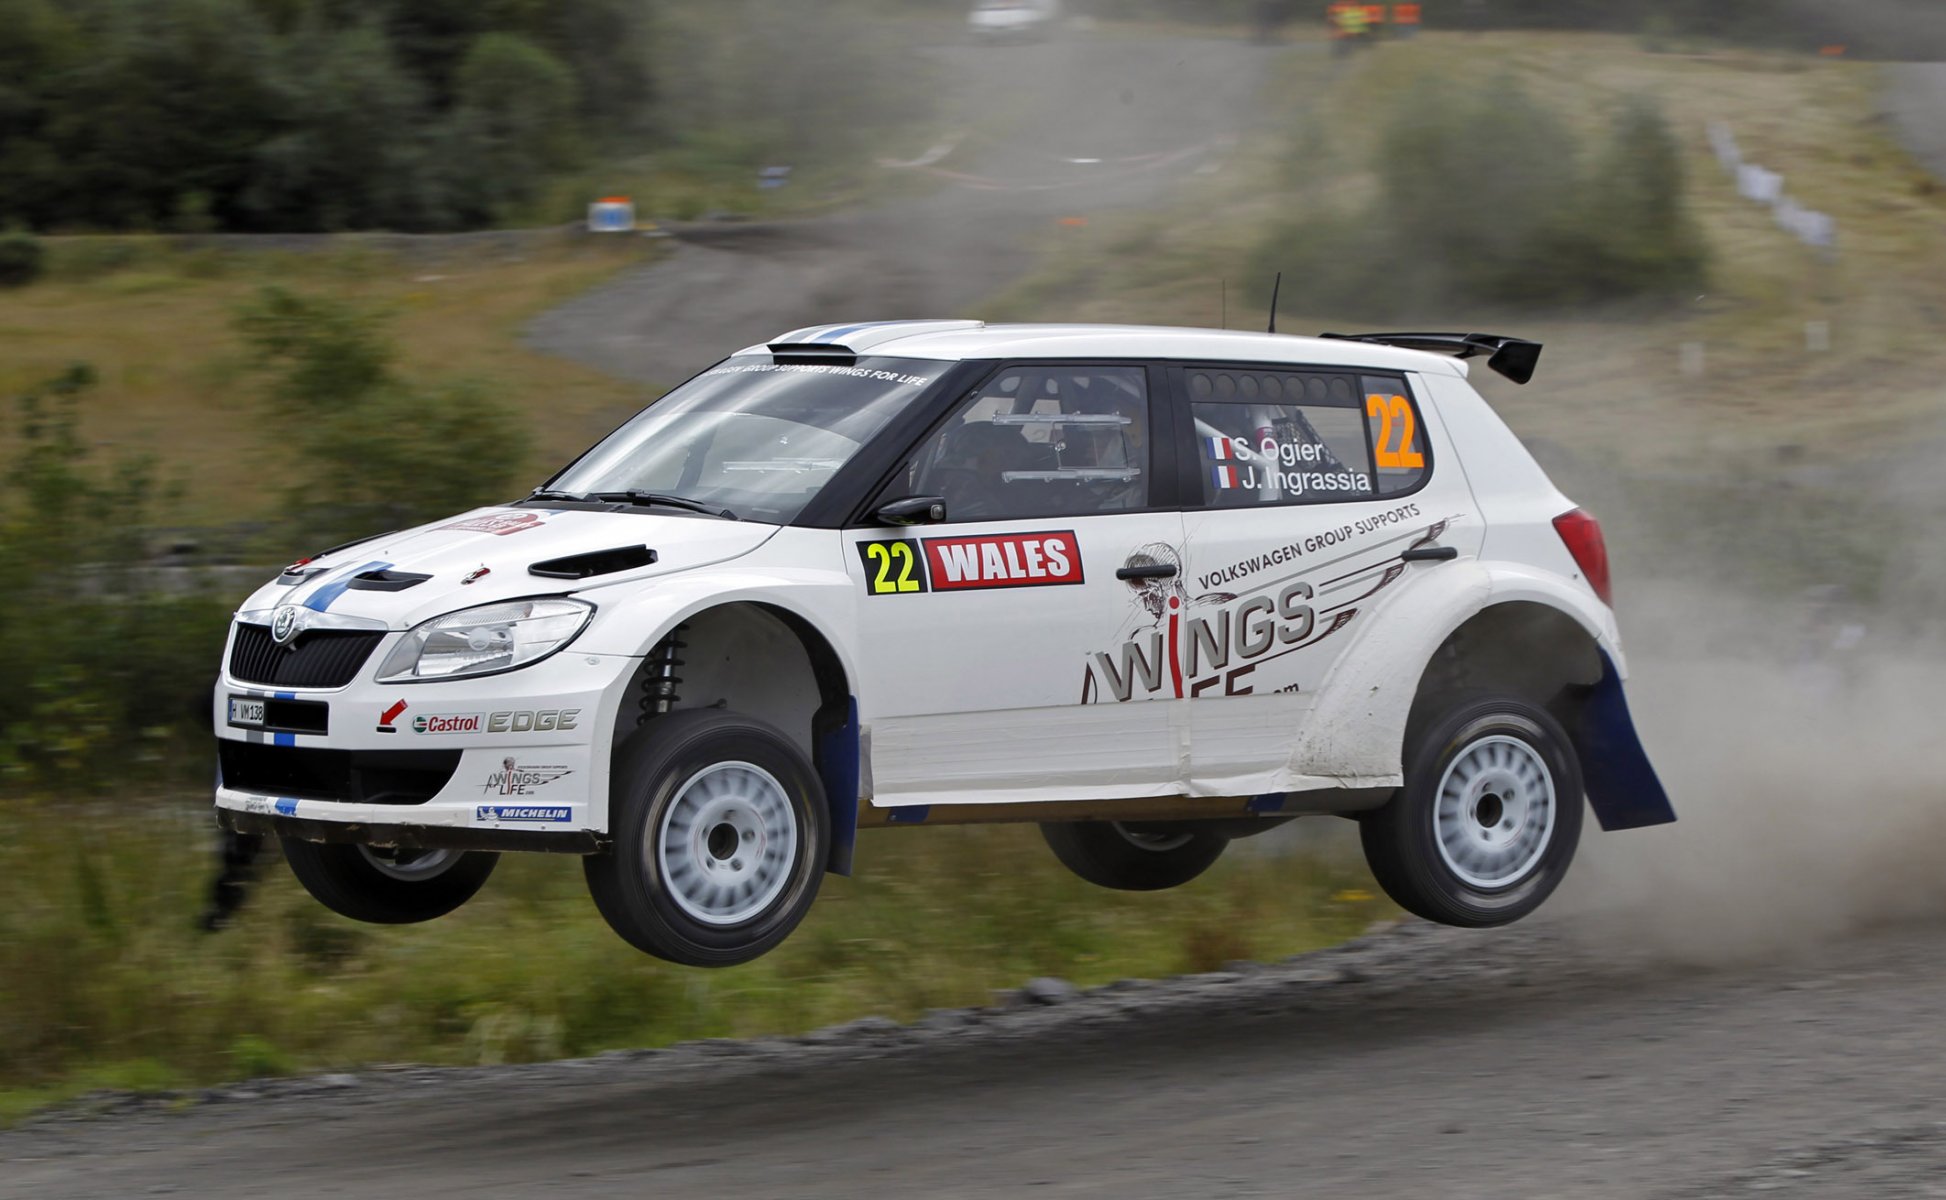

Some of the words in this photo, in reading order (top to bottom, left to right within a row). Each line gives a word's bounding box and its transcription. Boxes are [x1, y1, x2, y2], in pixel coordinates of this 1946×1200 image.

[829, 366, 872, 377] WINGS
[869, 370, 899, 381] FOR
[897, 374, 928, 386] LIFE
[1366, 394, 1425, 468] 22
[1234, 437, 1258, 461] S.
[1260, 437, 1323, 467] Ogier
[1242, 466, 1262, 489] J.
[1267, 467, 1371, 495] Ingrassia
[1199, 542, 1303, 590] VOLKSWAGEN
[1304, 525, 1353, 553] GROUP
[1355, 503, 1421, 535] SUPPORTS
[867, 541, 920, 593] 22
[937, 538, 1071, 582] WALES
[428, 715, 479, 732] Castrol
[487, 709, 581, 733] EDGE
[501, 808, 568, 818] MICHELIN
